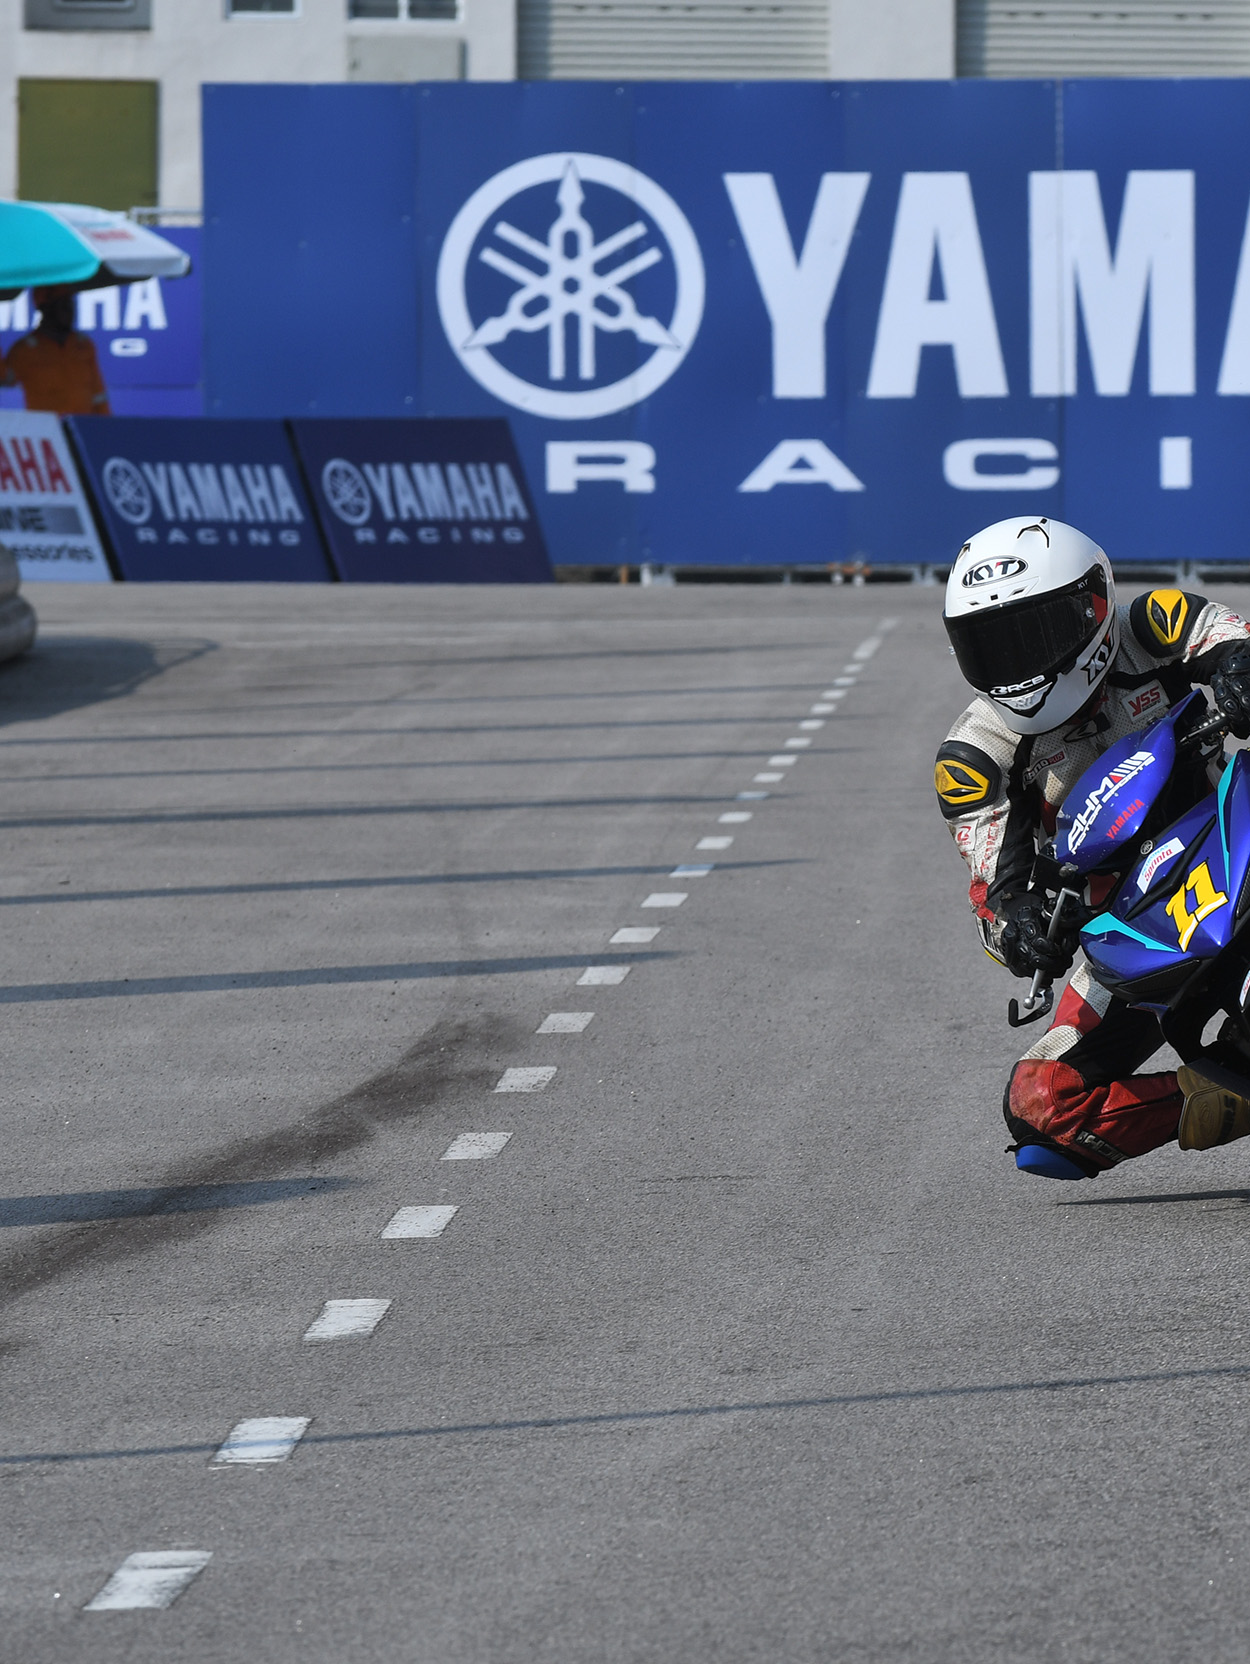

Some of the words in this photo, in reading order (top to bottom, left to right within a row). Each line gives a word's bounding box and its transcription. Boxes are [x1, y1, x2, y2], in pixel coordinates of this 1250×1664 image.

[141, 462, 304, 523] YAMAHA
[361, 462, 529, 521] YAMAHA
[136, 526, 301, 546] RACING
[354, 526, 525, 545] RACING
[966, 559, 1021, 586] KYT
[1128, 686, 1160, 717] YSS
[1106, 798, 1145, 840] YAMAHA
[1144, 847, 1174, 882] Sprinta
[1165, 860, 1229, 953] 11
